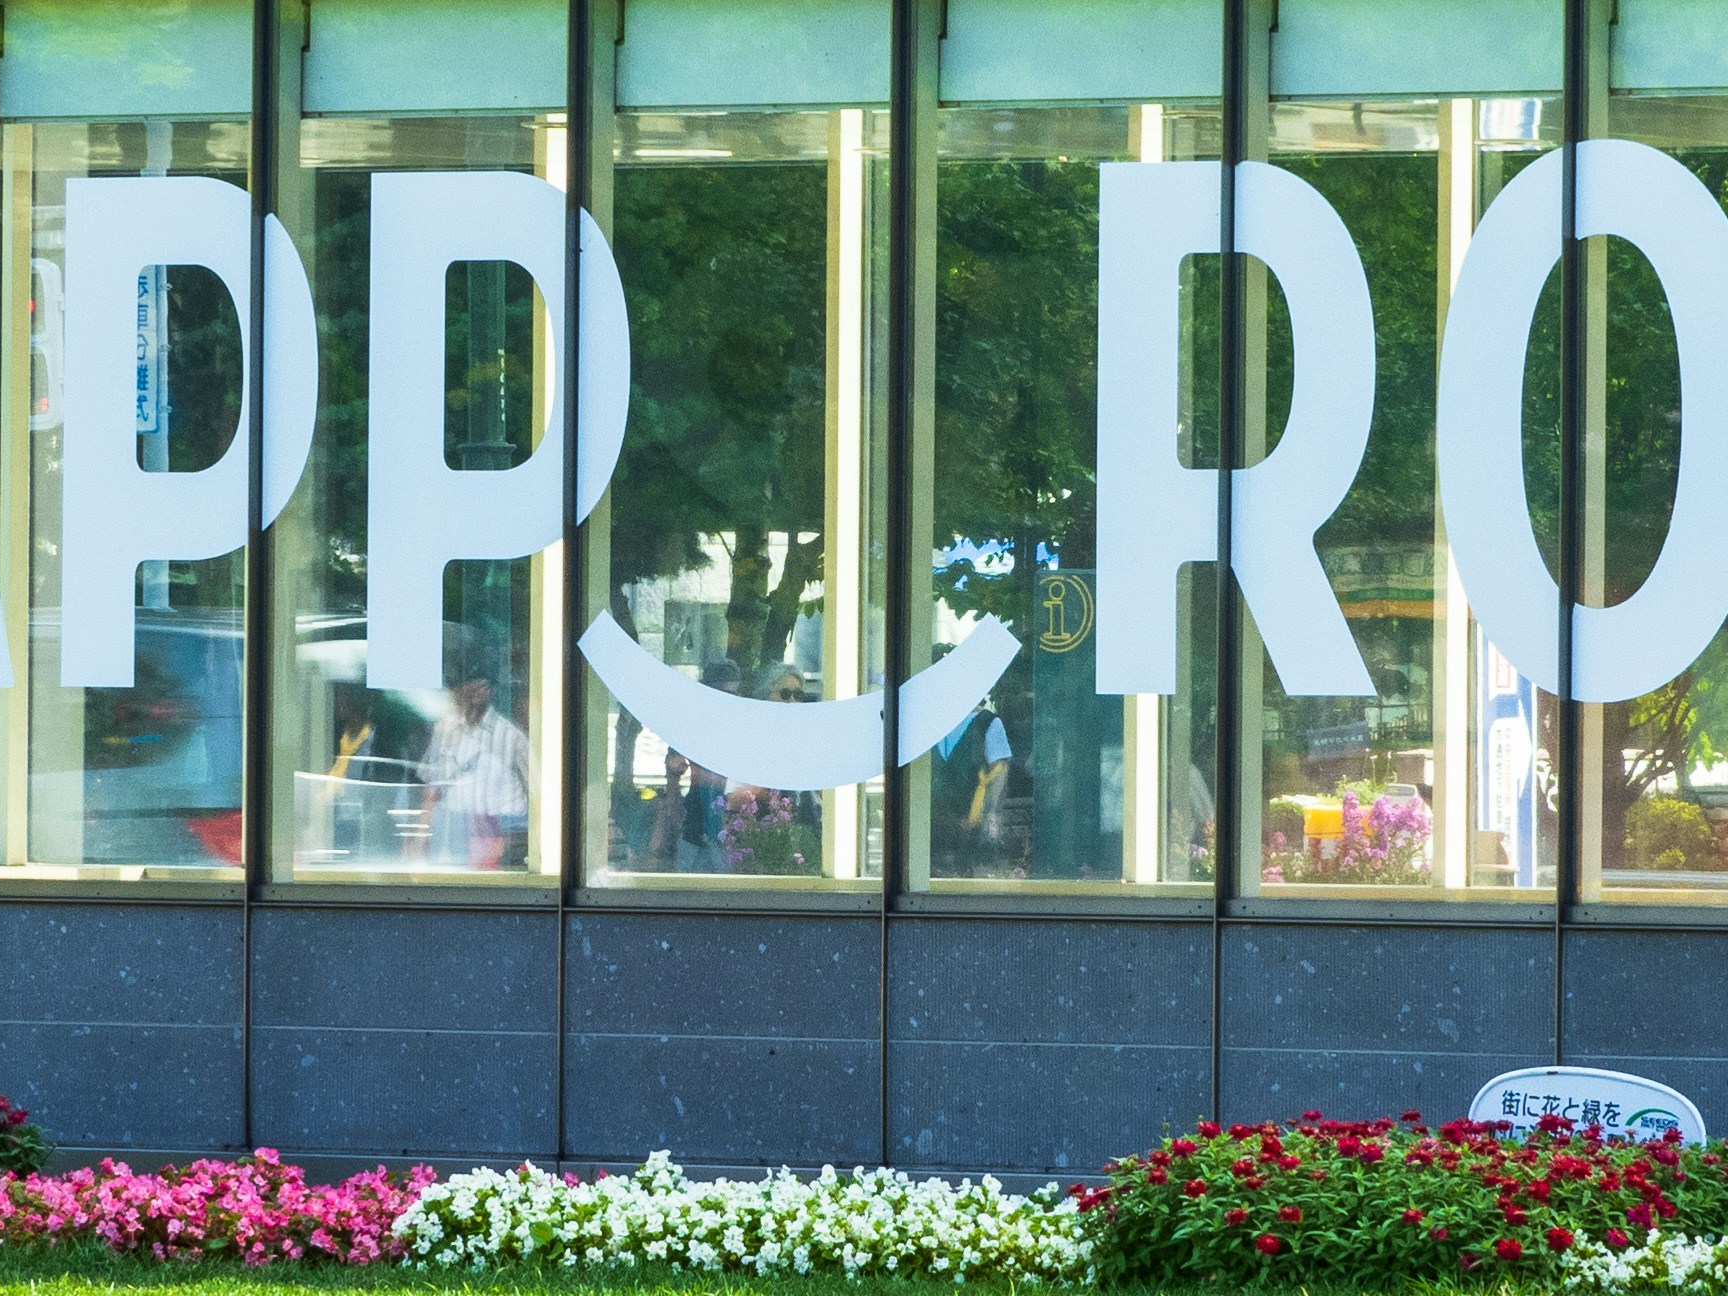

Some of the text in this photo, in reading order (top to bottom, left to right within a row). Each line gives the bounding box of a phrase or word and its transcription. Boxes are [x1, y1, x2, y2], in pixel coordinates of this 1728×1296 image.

[1500, 1089, 1622, 1128] 街に花と緑を
